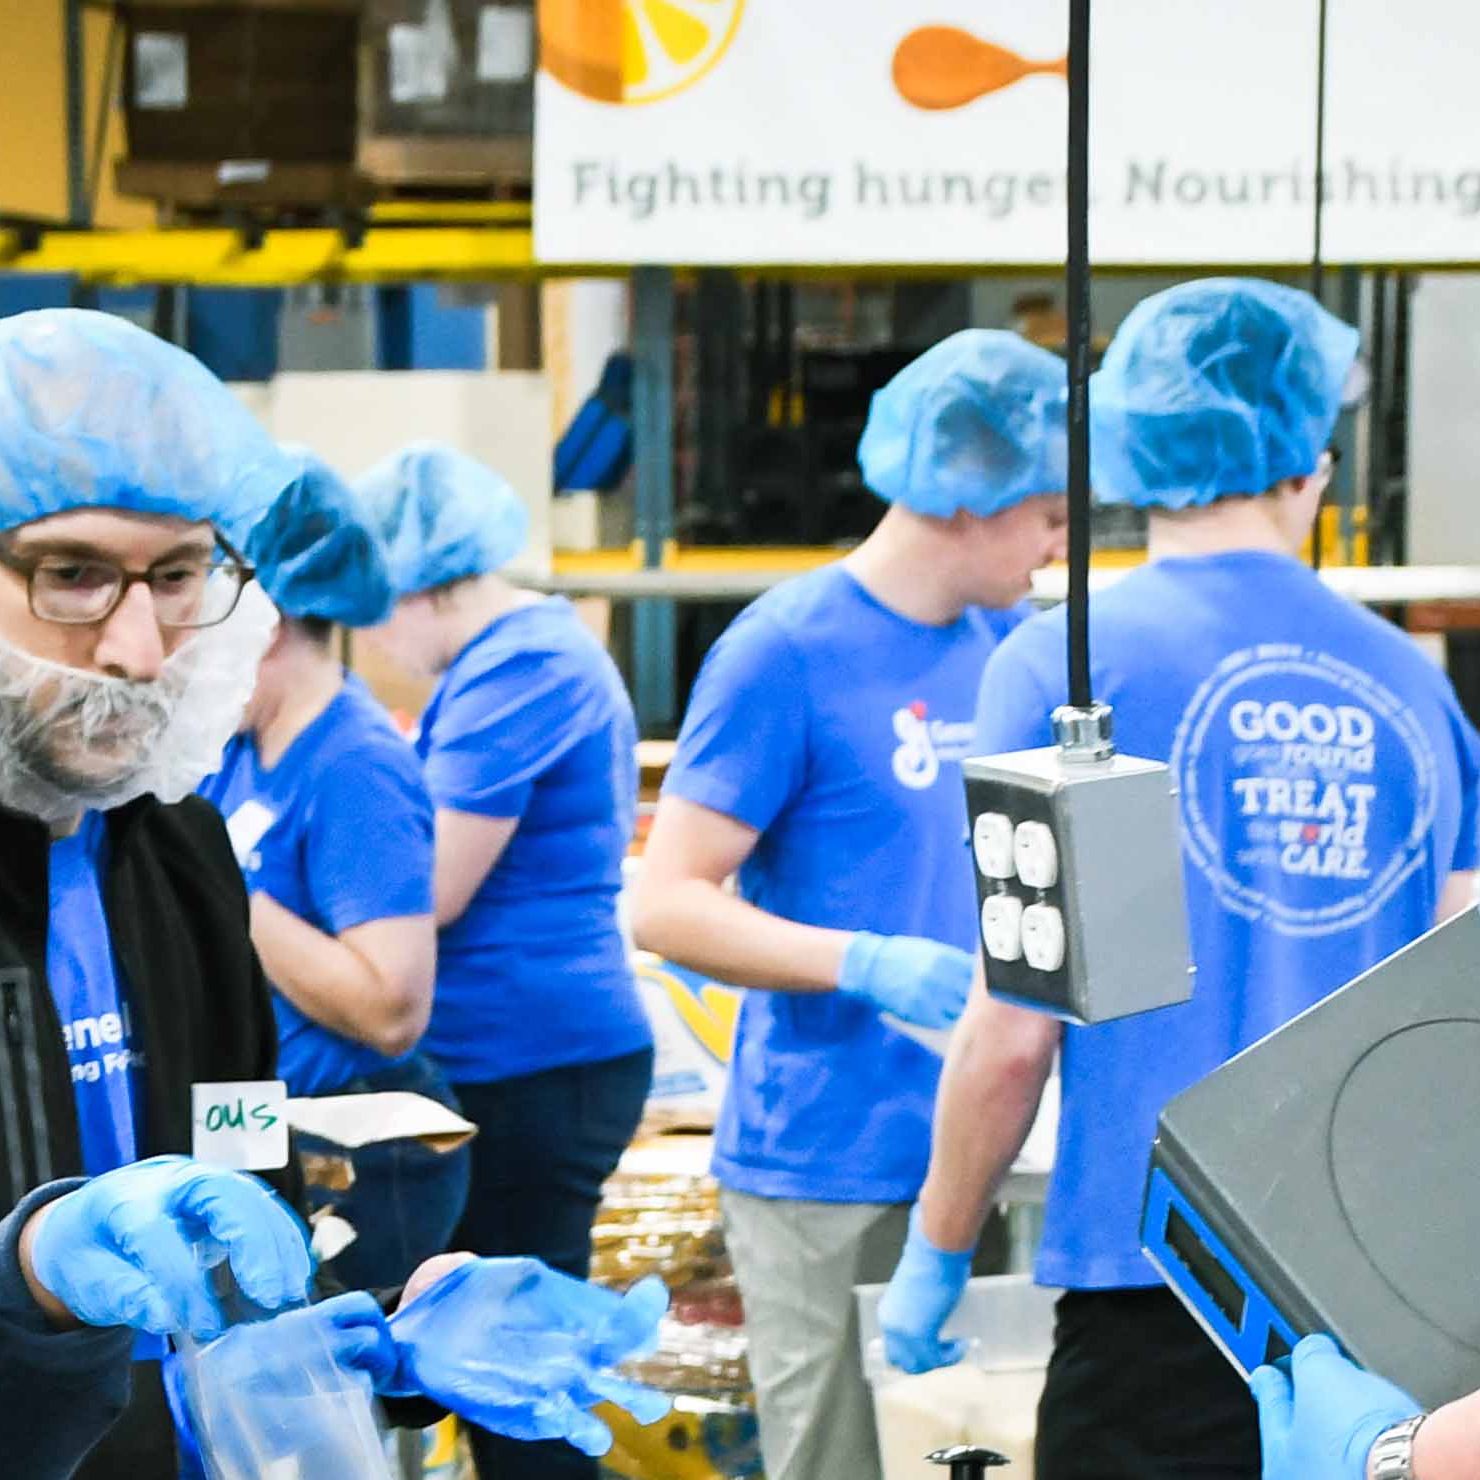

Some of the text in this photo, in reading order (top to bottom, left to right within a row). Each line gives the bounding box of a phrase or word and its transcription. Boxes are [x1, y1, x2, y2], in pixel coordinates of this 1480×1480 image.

[571, 158, 832, 220] Fighting
[855, 160, 1067, 220] hunge
[1229, 699, 1375, 747] GOOD
[1232, 777, 1376, 822] TREAT
